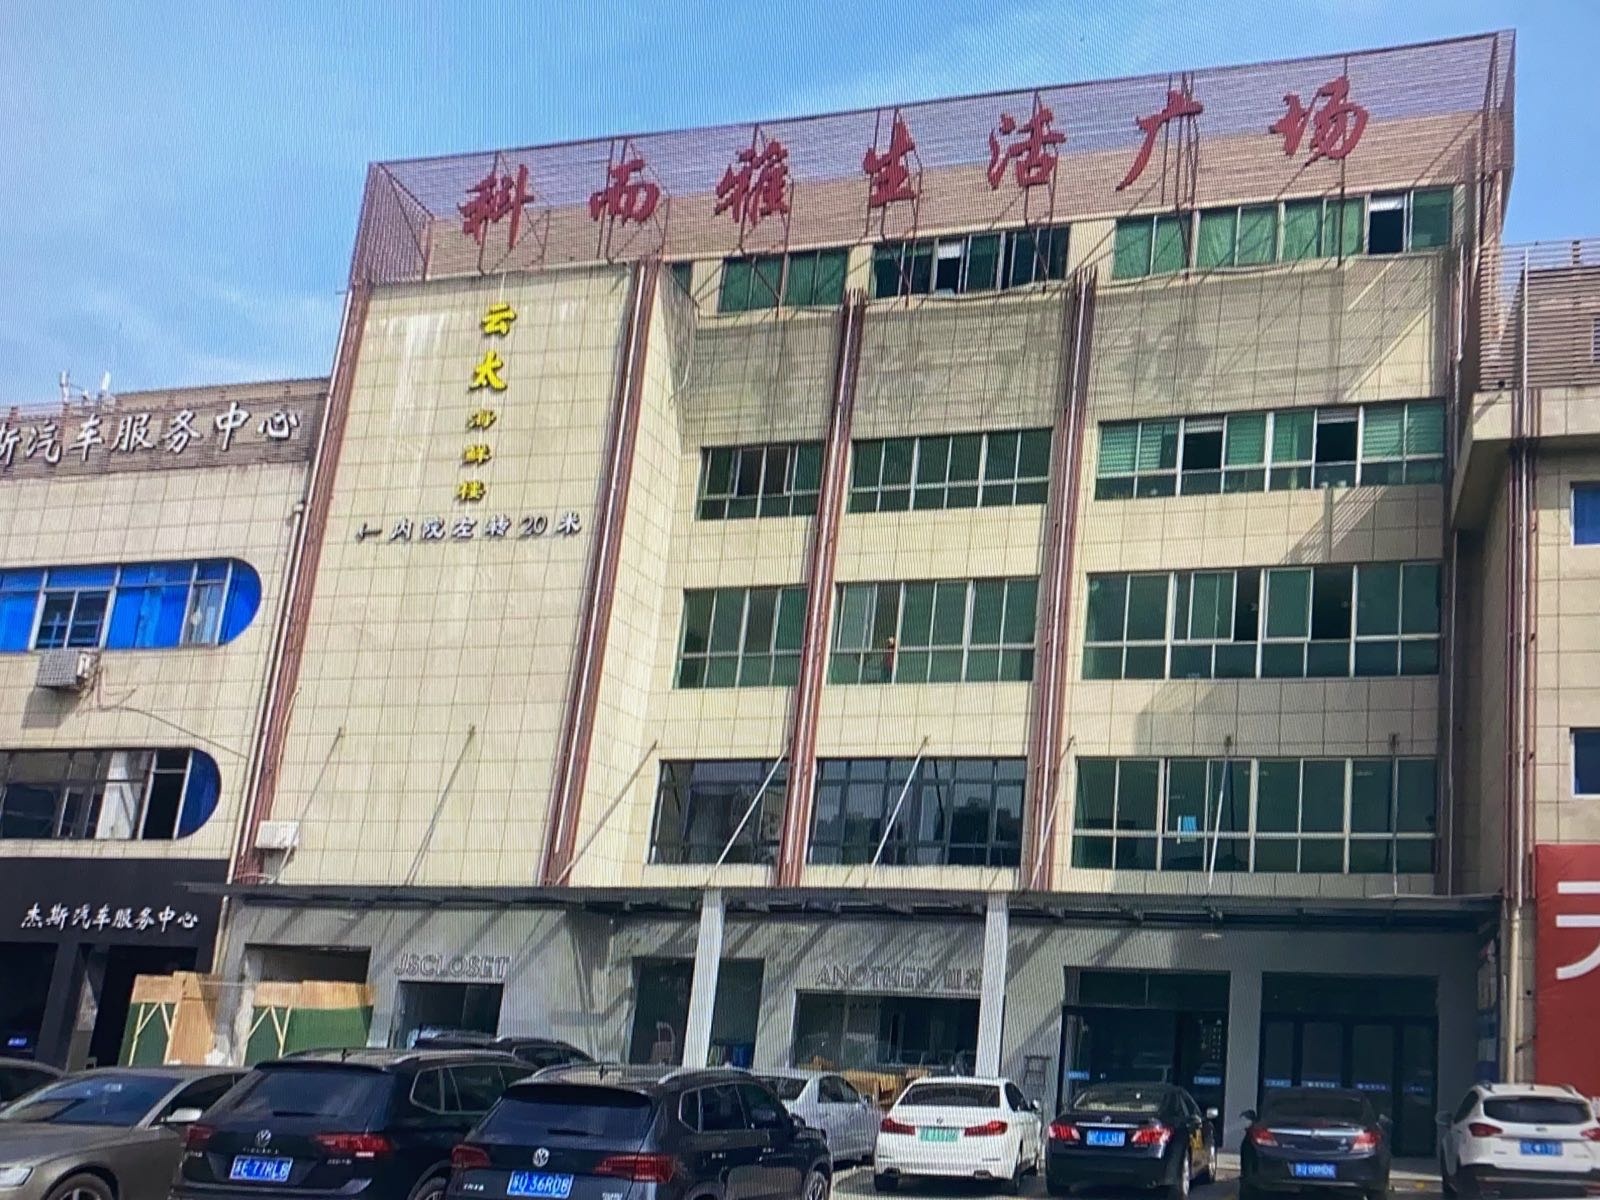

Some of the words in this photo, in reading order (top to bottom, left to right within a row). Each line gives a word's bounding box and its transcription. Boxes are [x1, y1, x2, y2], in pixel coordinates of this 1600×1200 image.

[20, 902, 199, 932] 杰斯汽车服务中心
